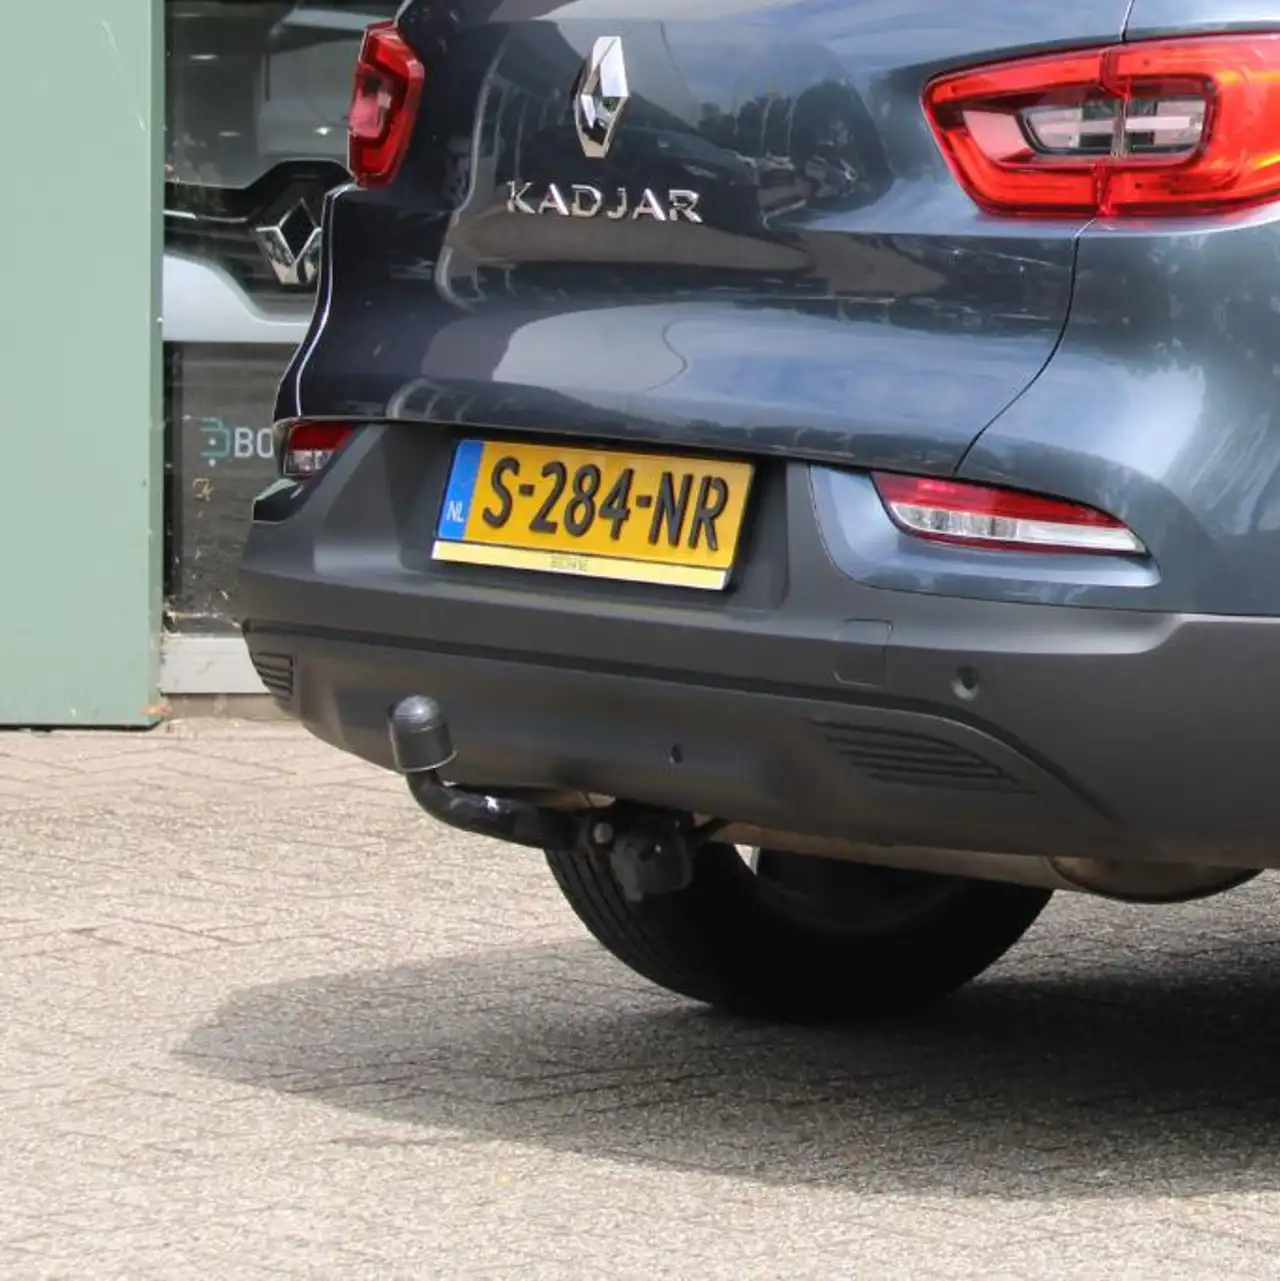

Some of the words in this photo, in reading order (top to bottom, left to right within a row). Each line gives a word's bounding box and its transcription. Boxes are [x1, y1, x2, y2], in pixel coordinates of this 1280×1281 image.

[505, 180, 703, 223] KADJAR
[446, 500, 465, 523] NL
[482, 456, 729, 552] S-284-NR
